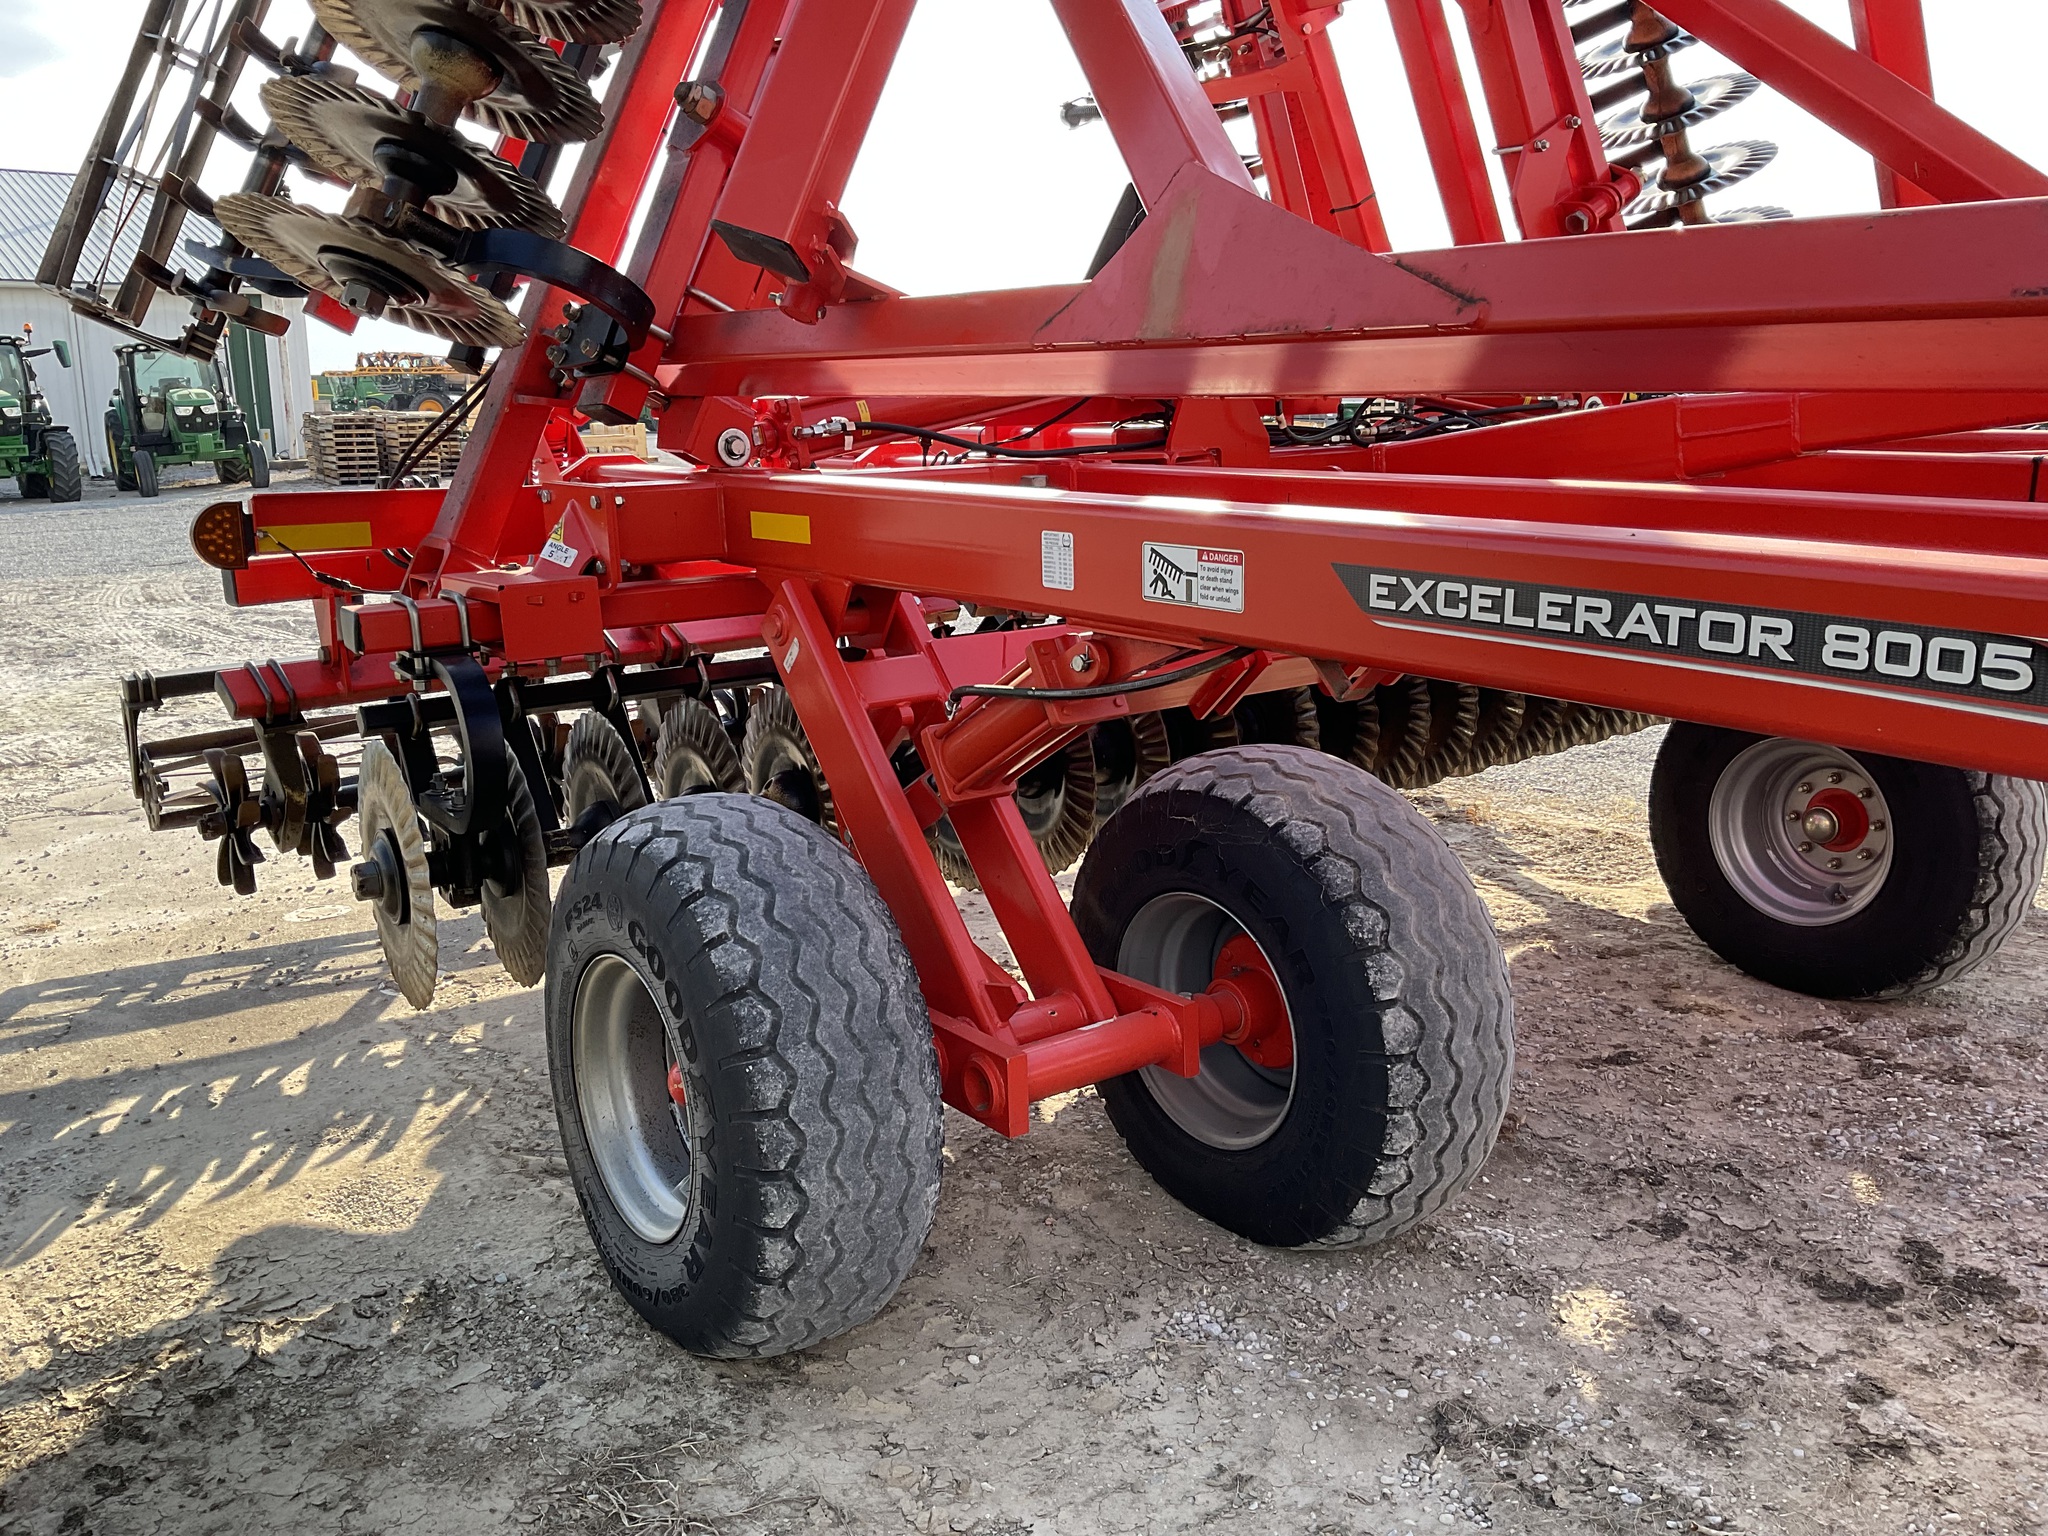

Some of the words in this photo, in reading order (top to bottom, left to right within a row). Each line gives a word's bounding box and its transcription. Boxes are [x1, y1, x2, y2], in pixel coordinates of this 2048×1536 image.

[549, 542, 569, 554] ANGLE
[1209, 552, 1239, 563] DANGER
[1220, 567, 1233, 576] injury
[1200, 592, 1209, 600] fold
[1225, 587, 1239, 596] wings
[1367, 573, 1796, 663] EXCELERATOR
[1821, 623, 2037, 693] 8005
[564, 892, 603, 933] FS24
